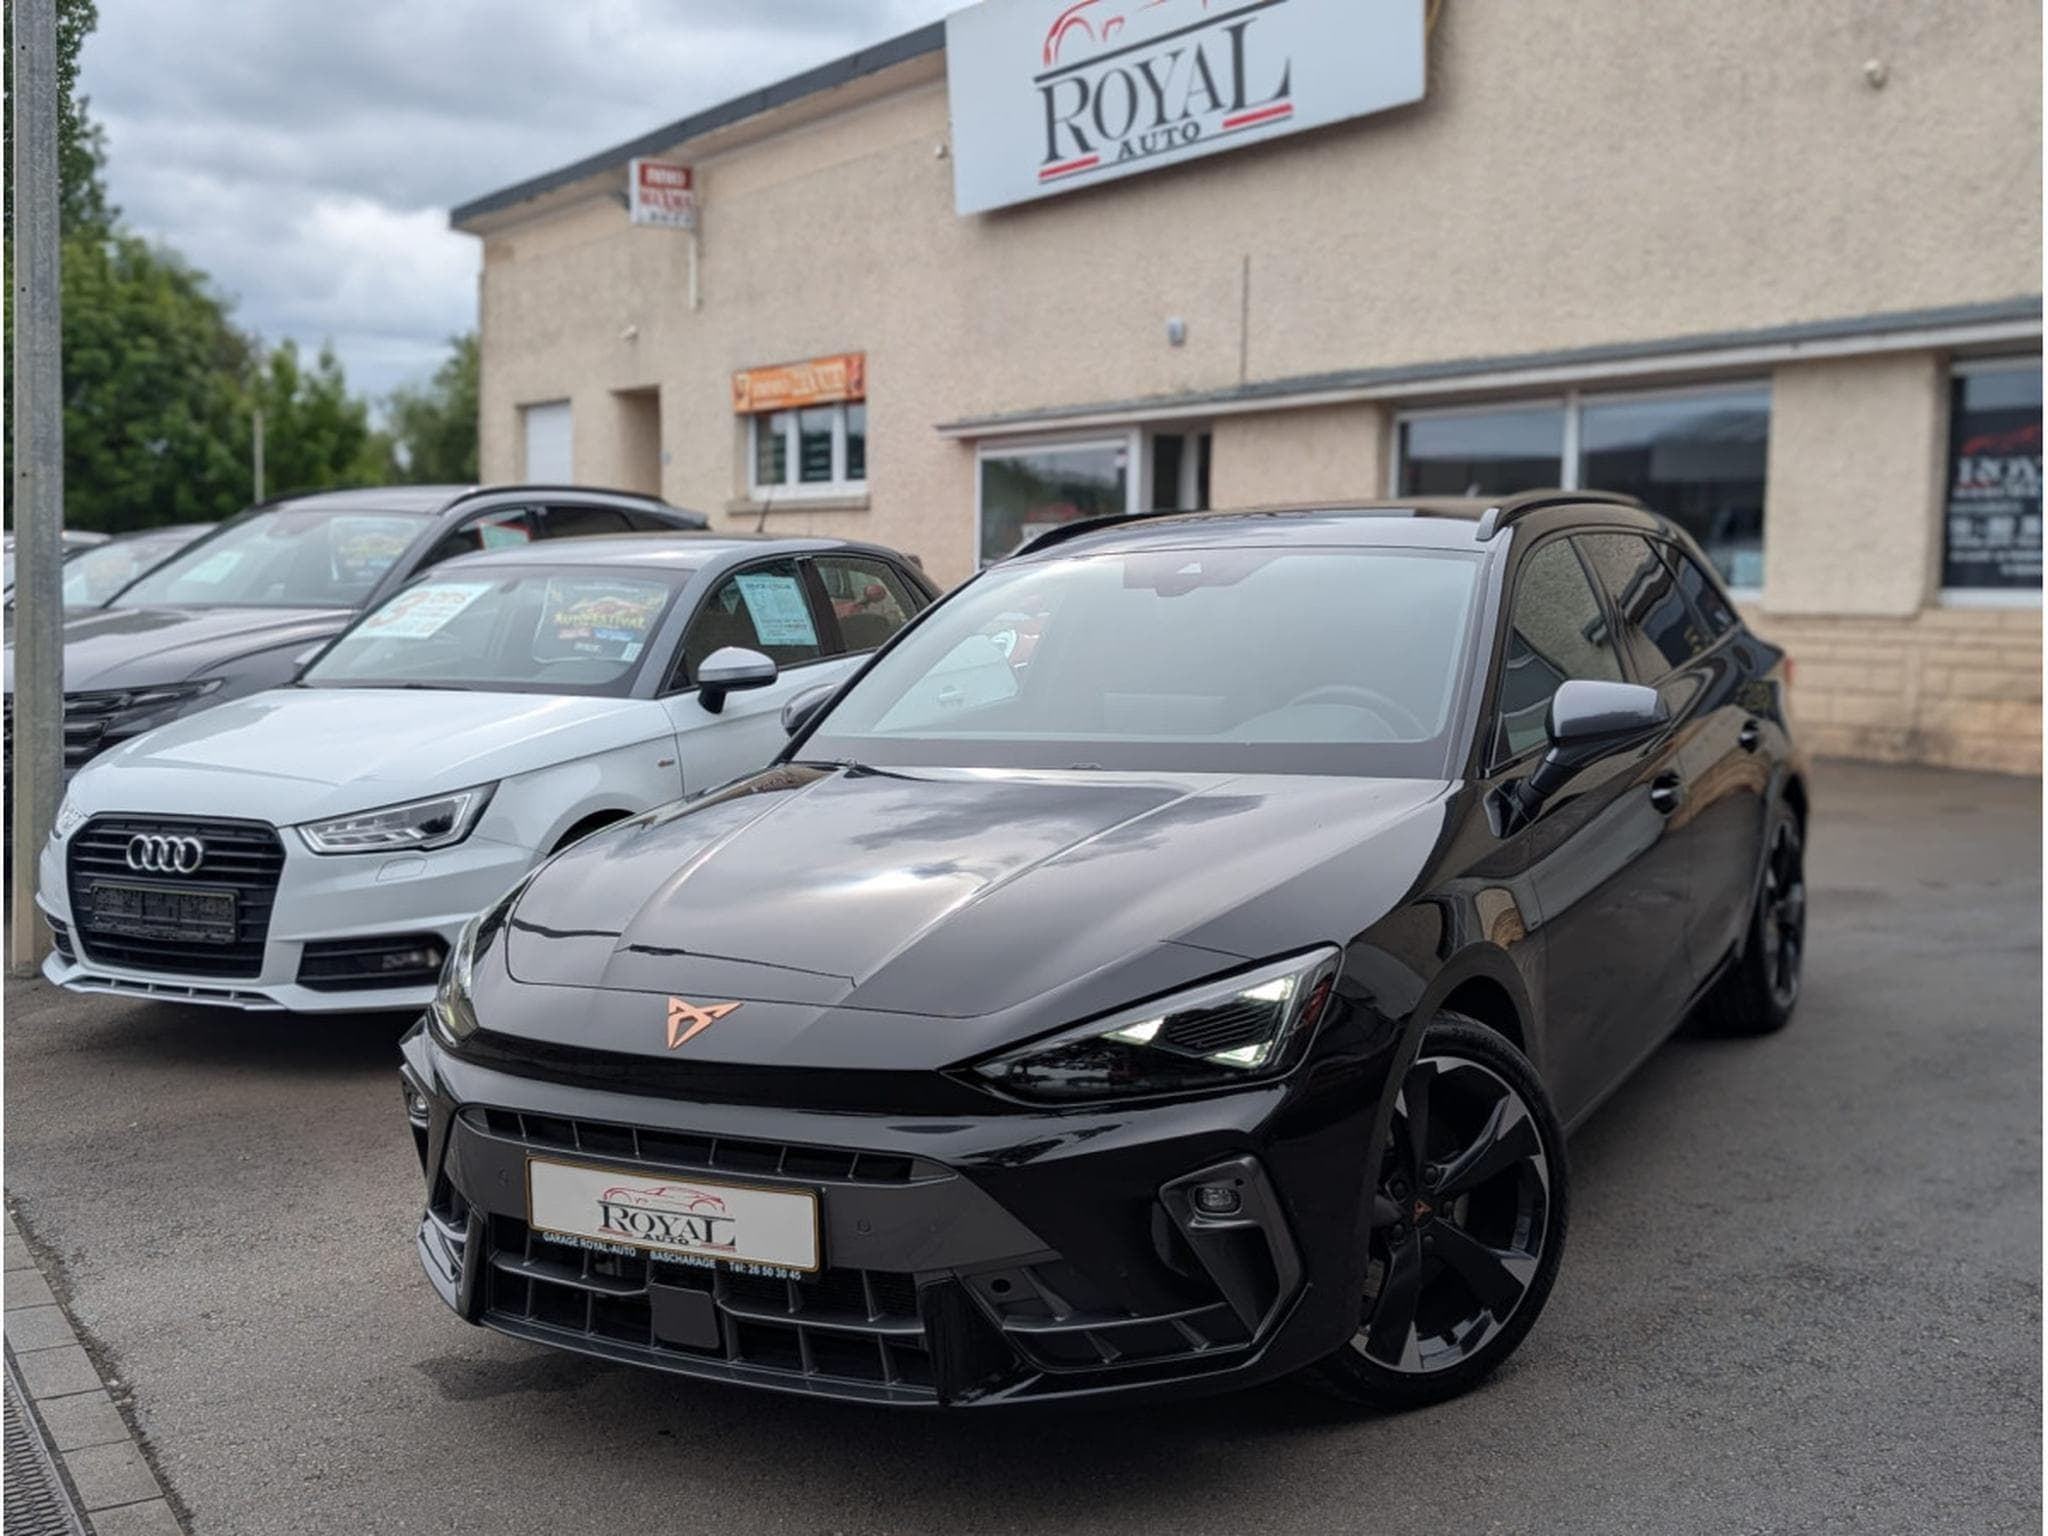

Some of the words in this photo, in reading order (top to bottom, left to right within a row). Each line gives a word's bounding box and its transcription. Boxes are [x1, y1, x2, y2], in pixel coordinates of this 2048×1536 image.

[1038, 17, 1291, 166] ROYAL
[1117, 122, 1201, 161] AUTO
[601, 1204, 735, 1246] ROYAL
[642, 1233, 690, 1246] AUTO
[543, 1232, 579, 1247] GARAGE
[580, 1239, 636, 1257] ROYAL-AUTO
[650, 1251, 716, 1269] BASCHARAGE
[749, 1263, 760, 1275] 26
[789, 1269, 801, 1281] 45
